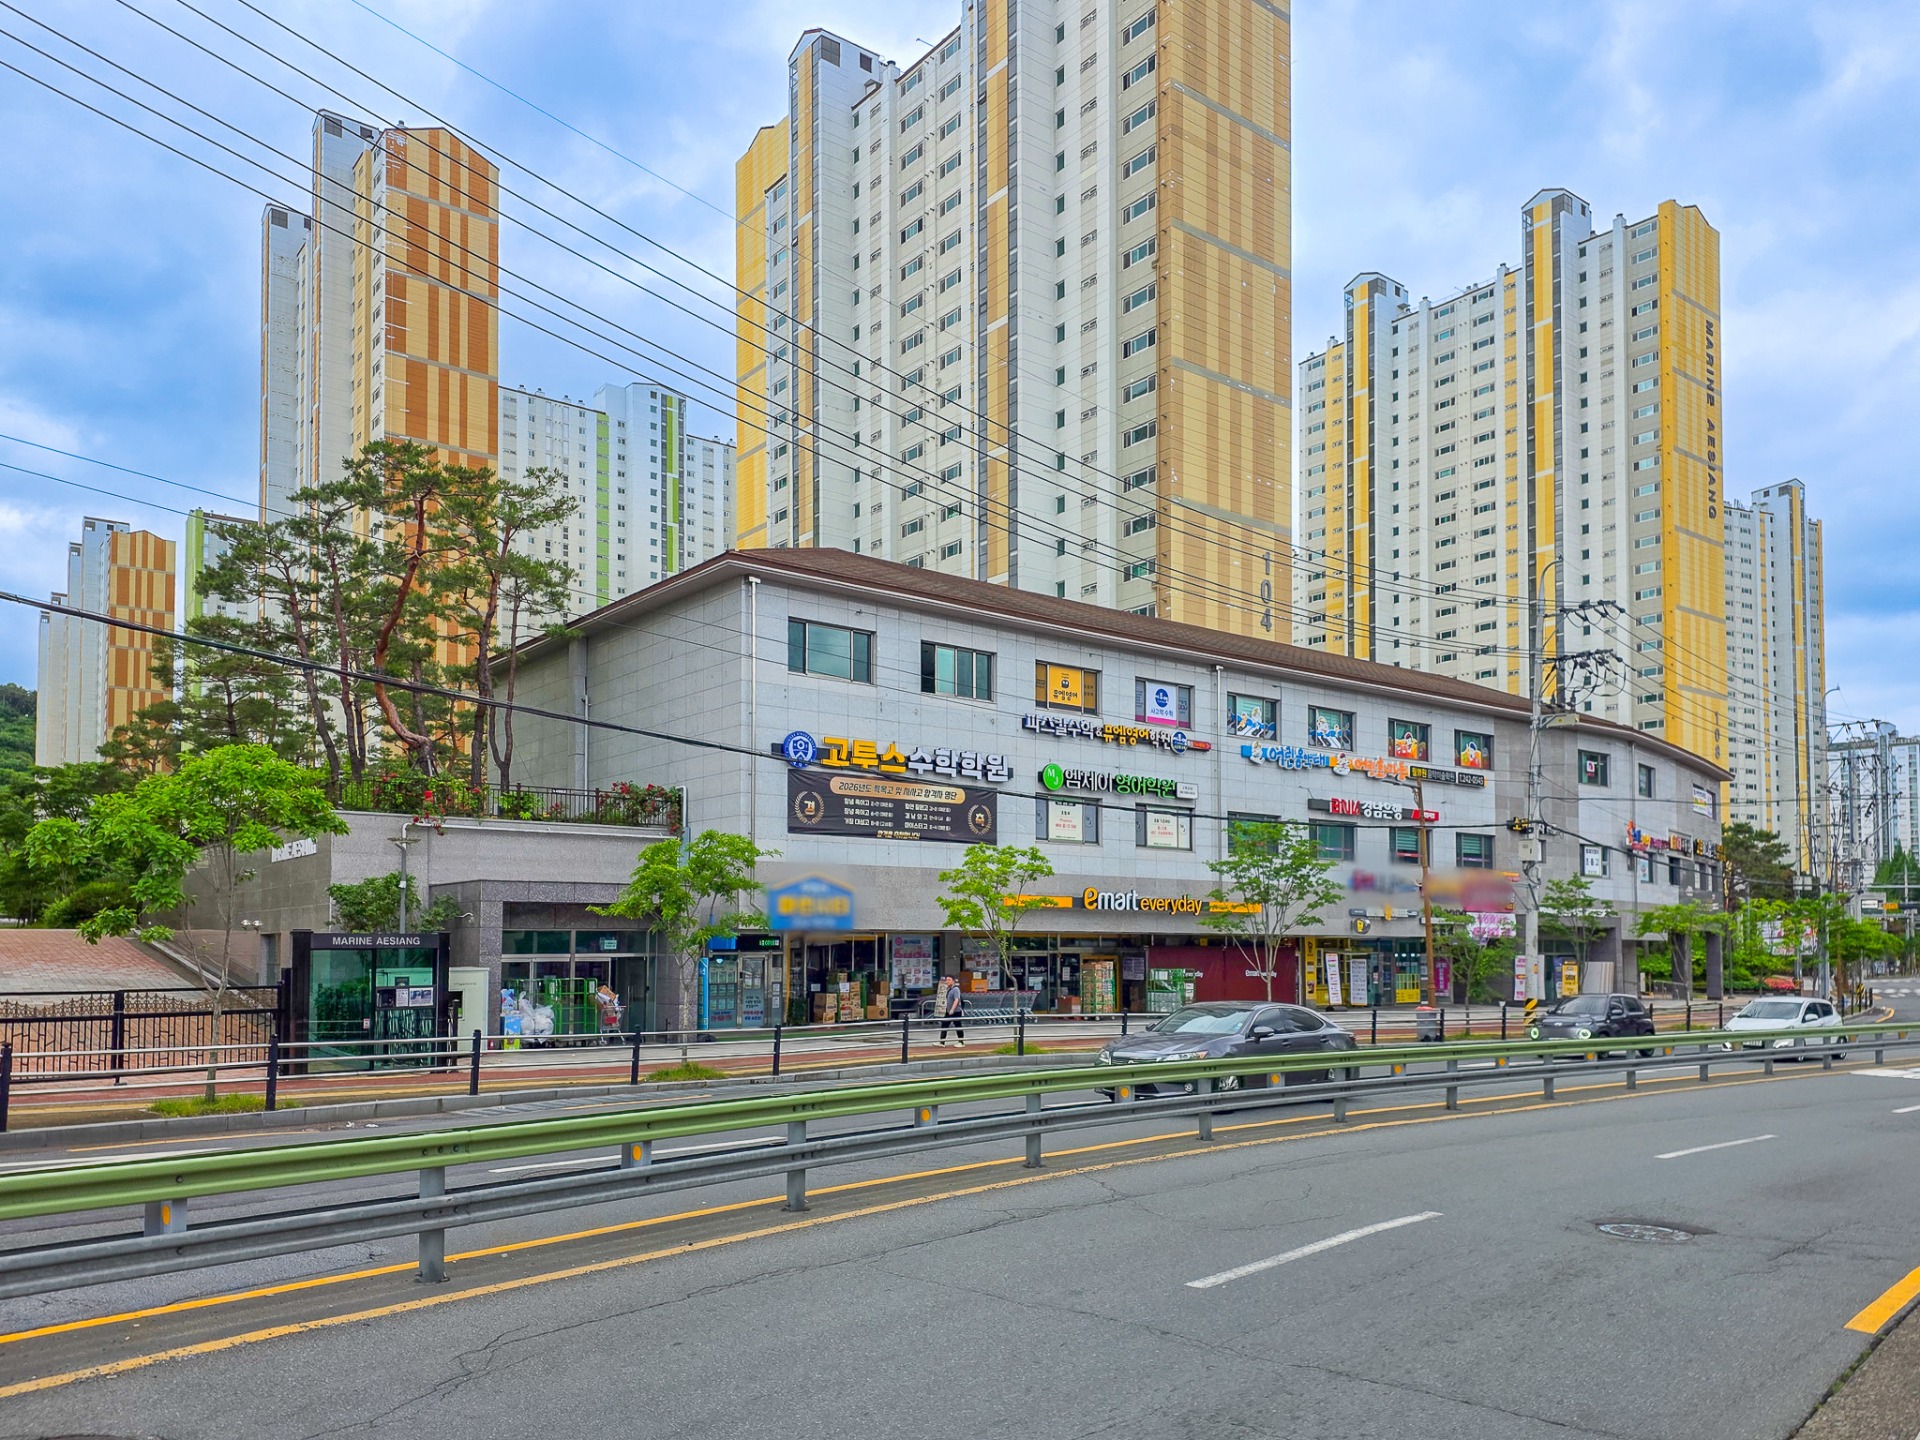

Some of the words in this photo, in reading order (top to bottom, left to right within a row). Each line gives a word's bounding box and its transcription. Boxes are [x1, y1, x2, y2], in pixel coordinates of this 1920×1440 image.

[1705, 319, 1715, 407] MARINE
[1706, 418, 1717, 520] AESIANG
[1260, 551, 1272, 632] 104
[1053, 689, 1077, 702] 뮤엠영어
[1024, 713, 1094, 740] 파스칼수학
[1095, 726, 1102, 737] &
[838, 781, 873, 793] 2026년도
[895, 786, 902, 796] 및
[944, 790, 958, 801] 명단
[1064, 768, 1113, 792] 엠제이
[1115, 773, 1176, 799] 영어학원
[1361, 800, 1403, 821] 경남은행
[1083, 886, 1139, 911] emart
[1140, 895, 1202, 916] everyday
[332, 936, 373, 945] MARINE
[376, 937, 421, 945] AESIANG
